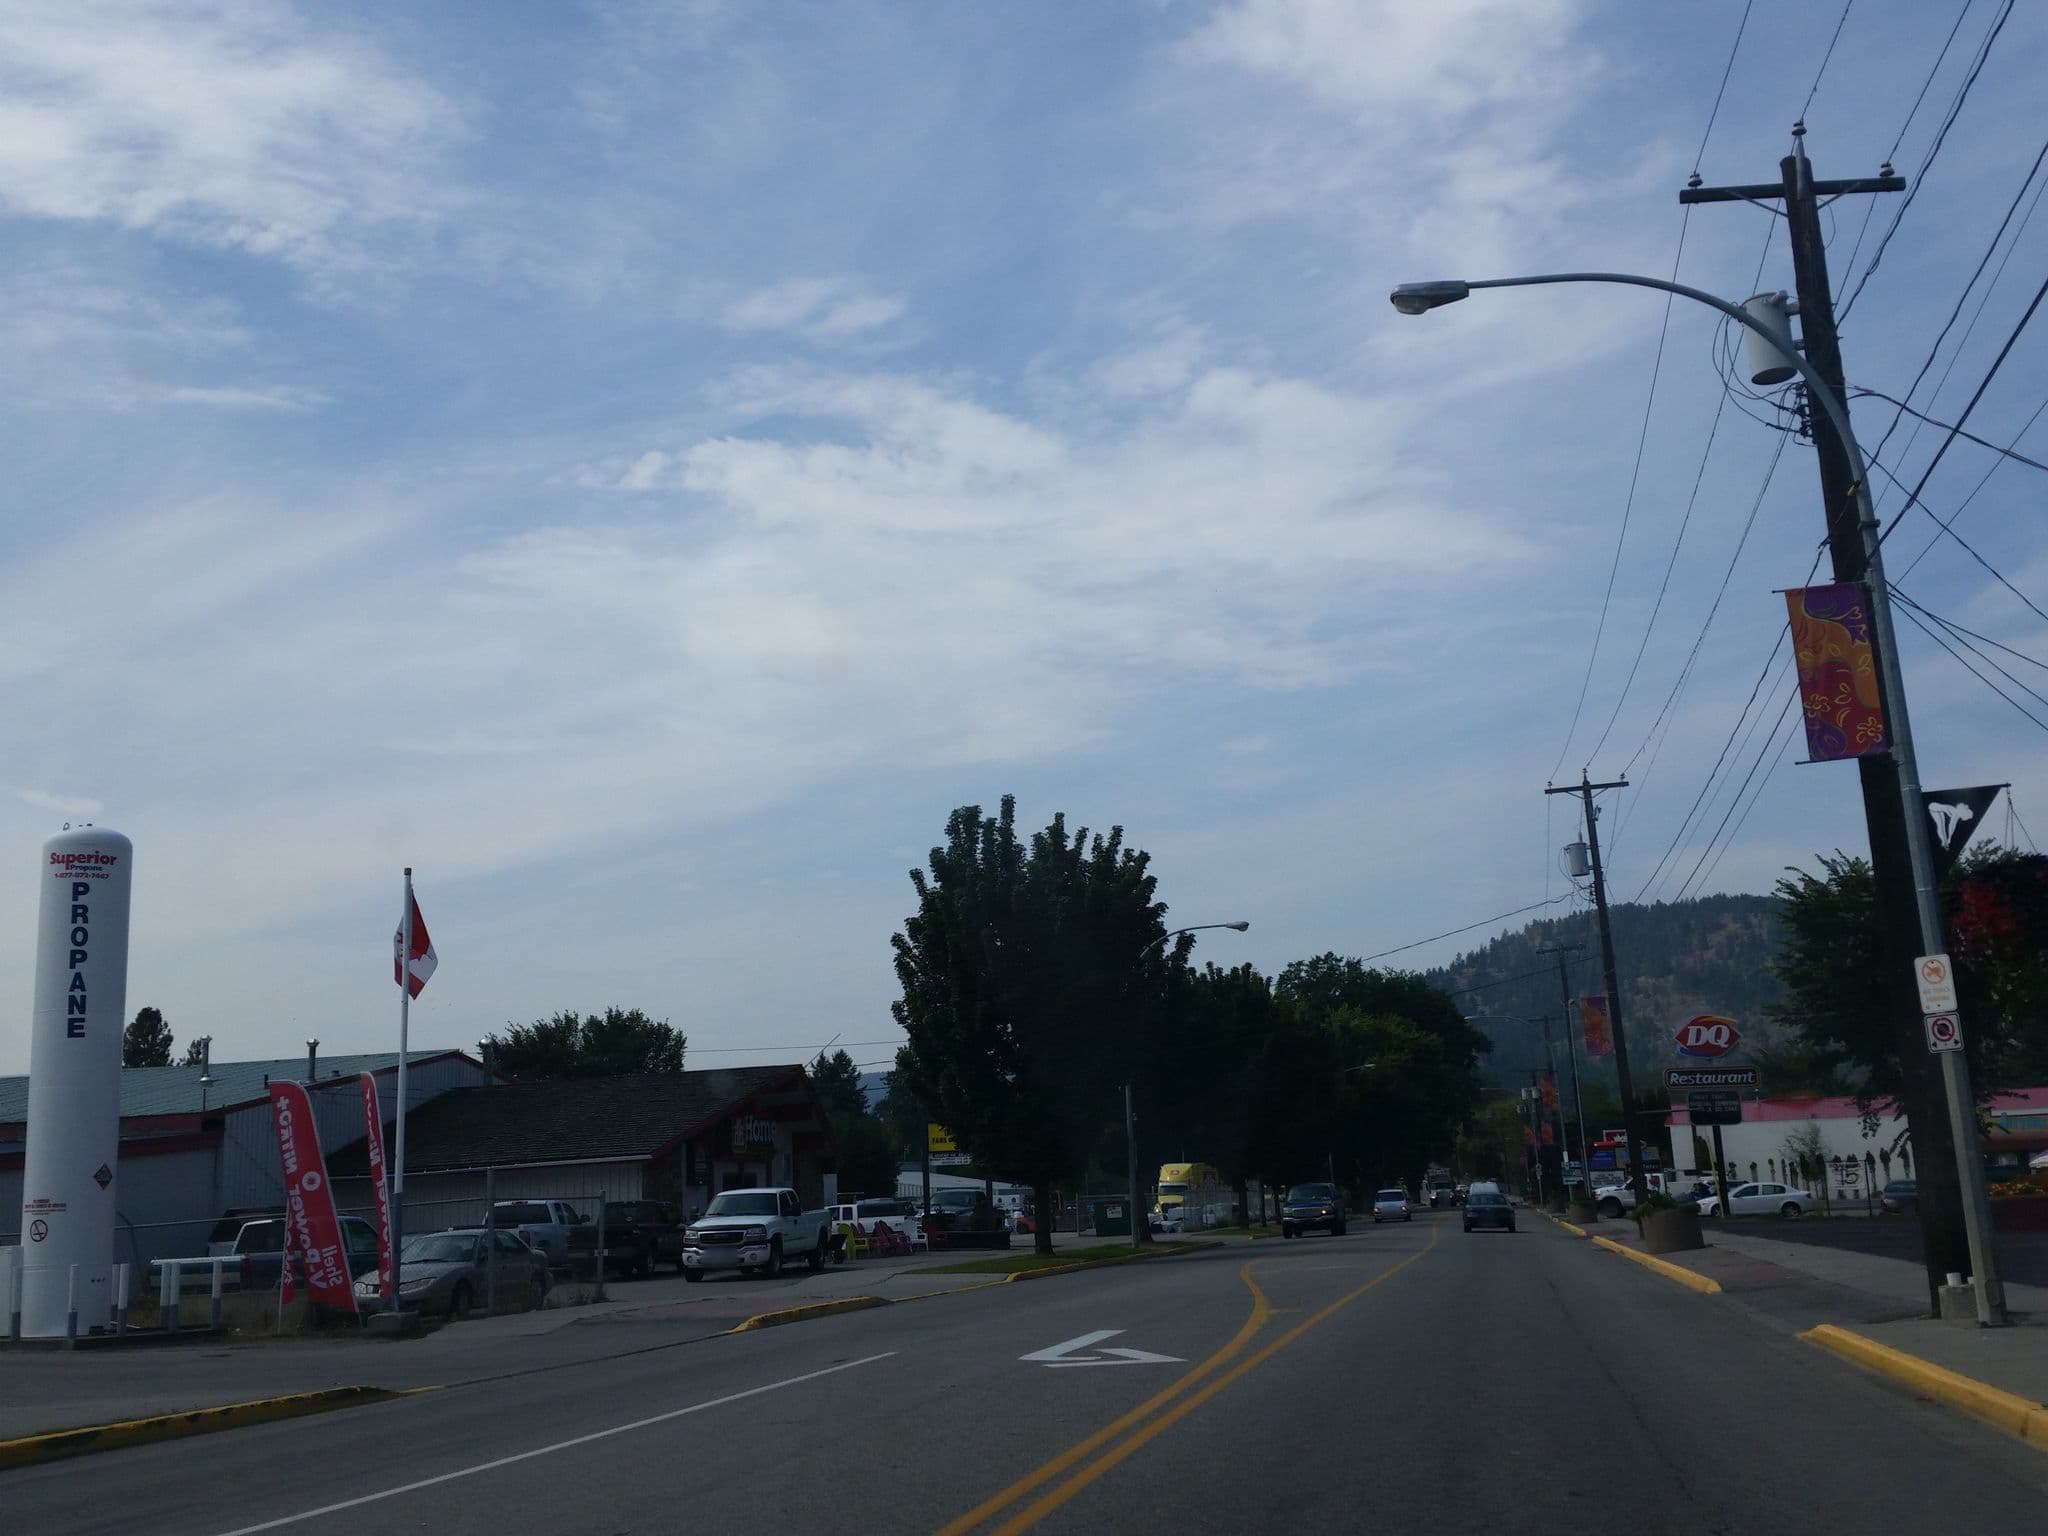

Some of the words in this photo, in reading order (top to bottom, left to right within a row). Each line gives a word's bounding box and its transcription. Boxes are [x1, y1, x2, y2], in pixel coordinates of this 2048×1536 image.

[50, 851, 117, 870] Superior
[70, 864, 103, 872] Propane
[66, 882, 90, 1038] PROPANE
[1686, 1024, 1731, 1049] DQ
[1670, 1072, 1756, 1085] Restaurant
